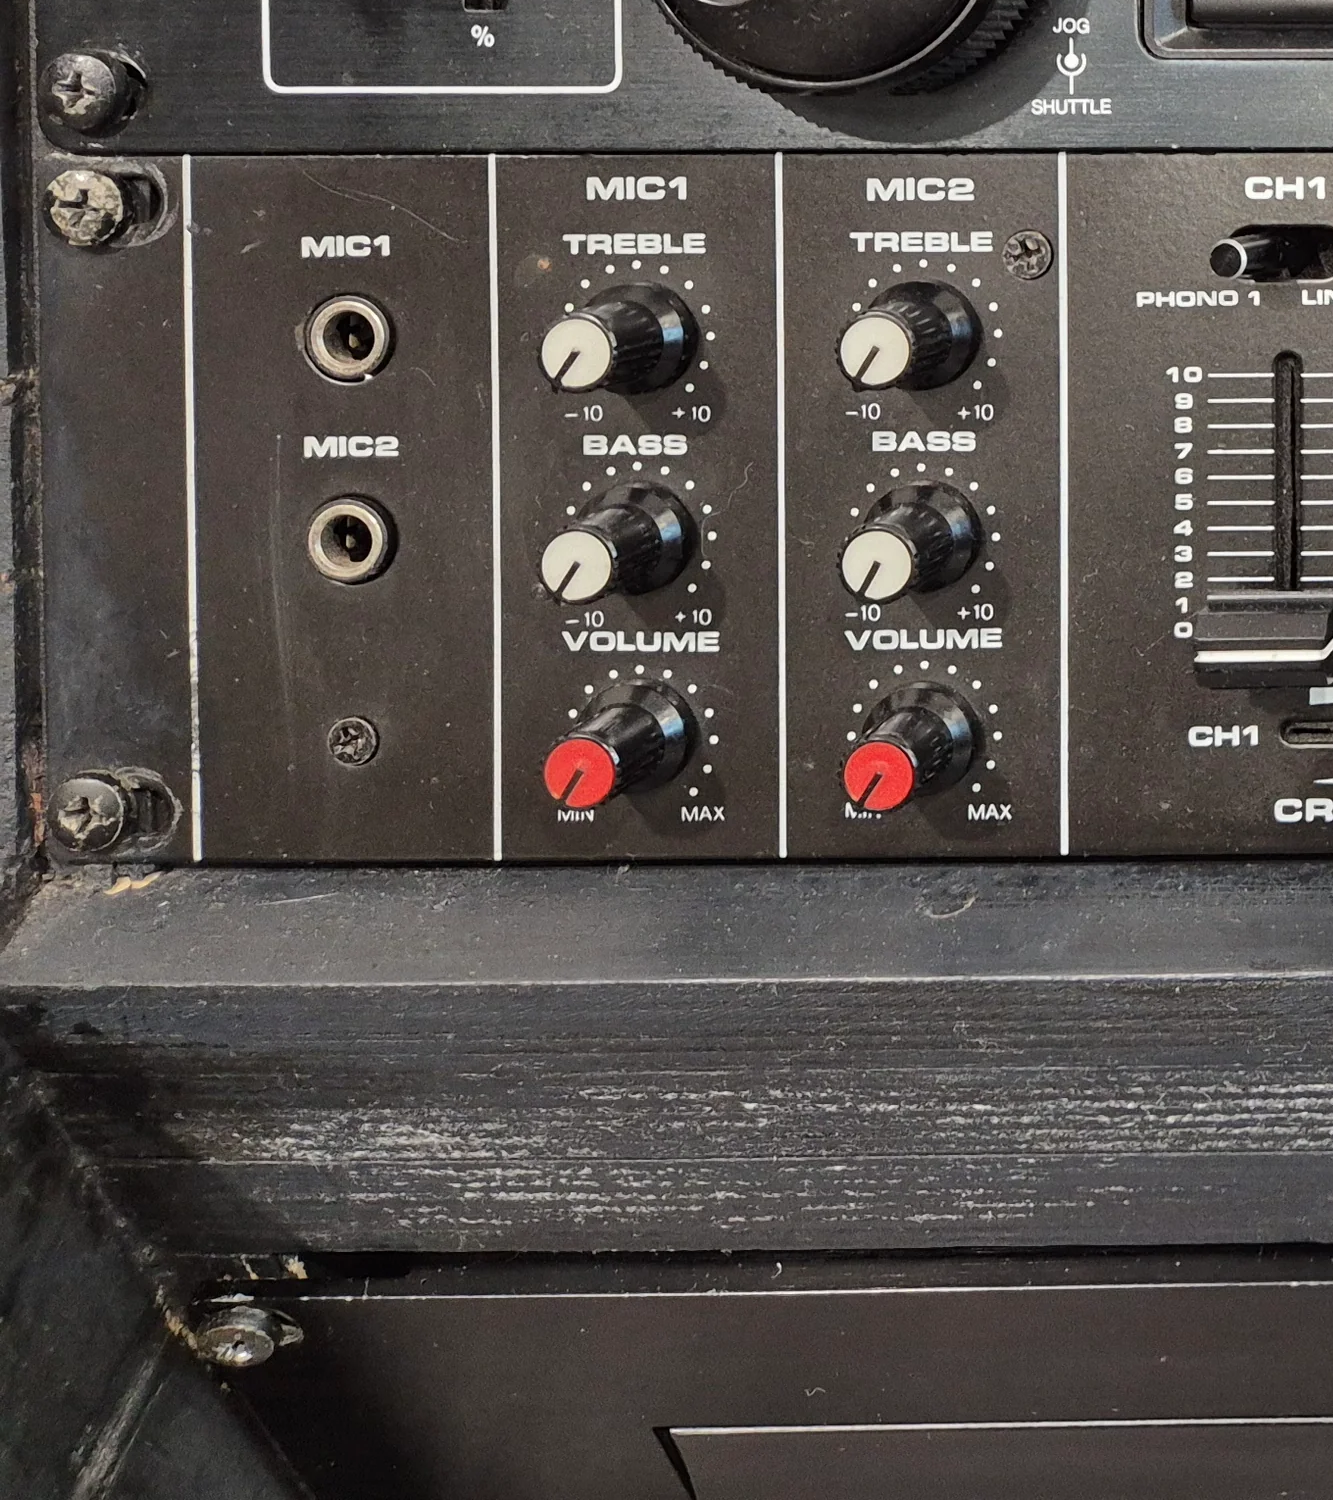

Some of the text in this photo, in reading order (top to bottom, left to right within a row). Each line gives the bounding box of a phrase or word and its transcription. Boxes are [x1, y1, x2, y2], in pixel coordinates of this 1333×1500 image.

[1052, 17, 1091, 35] JOG
[1030, 97, 1113, 116] SHUTTLE
[586, 176, 688, 201] MIC1
[866, 177, 975, 202] MIC2
[1244, 176, 1326, 200] CH1
[300, 234, 391, 258] MIC1
[562, 232, 707, 255] TREBLE
[849, 230, 994, 253] TREBLE
[1136, 289, 1261, 308] PHONO 1
[303, 435, 400, 458] MIC2
[583, 434, 688, 456] BASS
[872, 430, 977, 453] BASS
[561, 630, 720, 653] VOLUME
[844, 627, 1003, 651] VOLUME
[1187, 724, 1259, 747] CH1
[557, 809, 595, 822] MIN
[681, 805, 726, 822] MAX
[967, 803, 1013, 821] MAX
